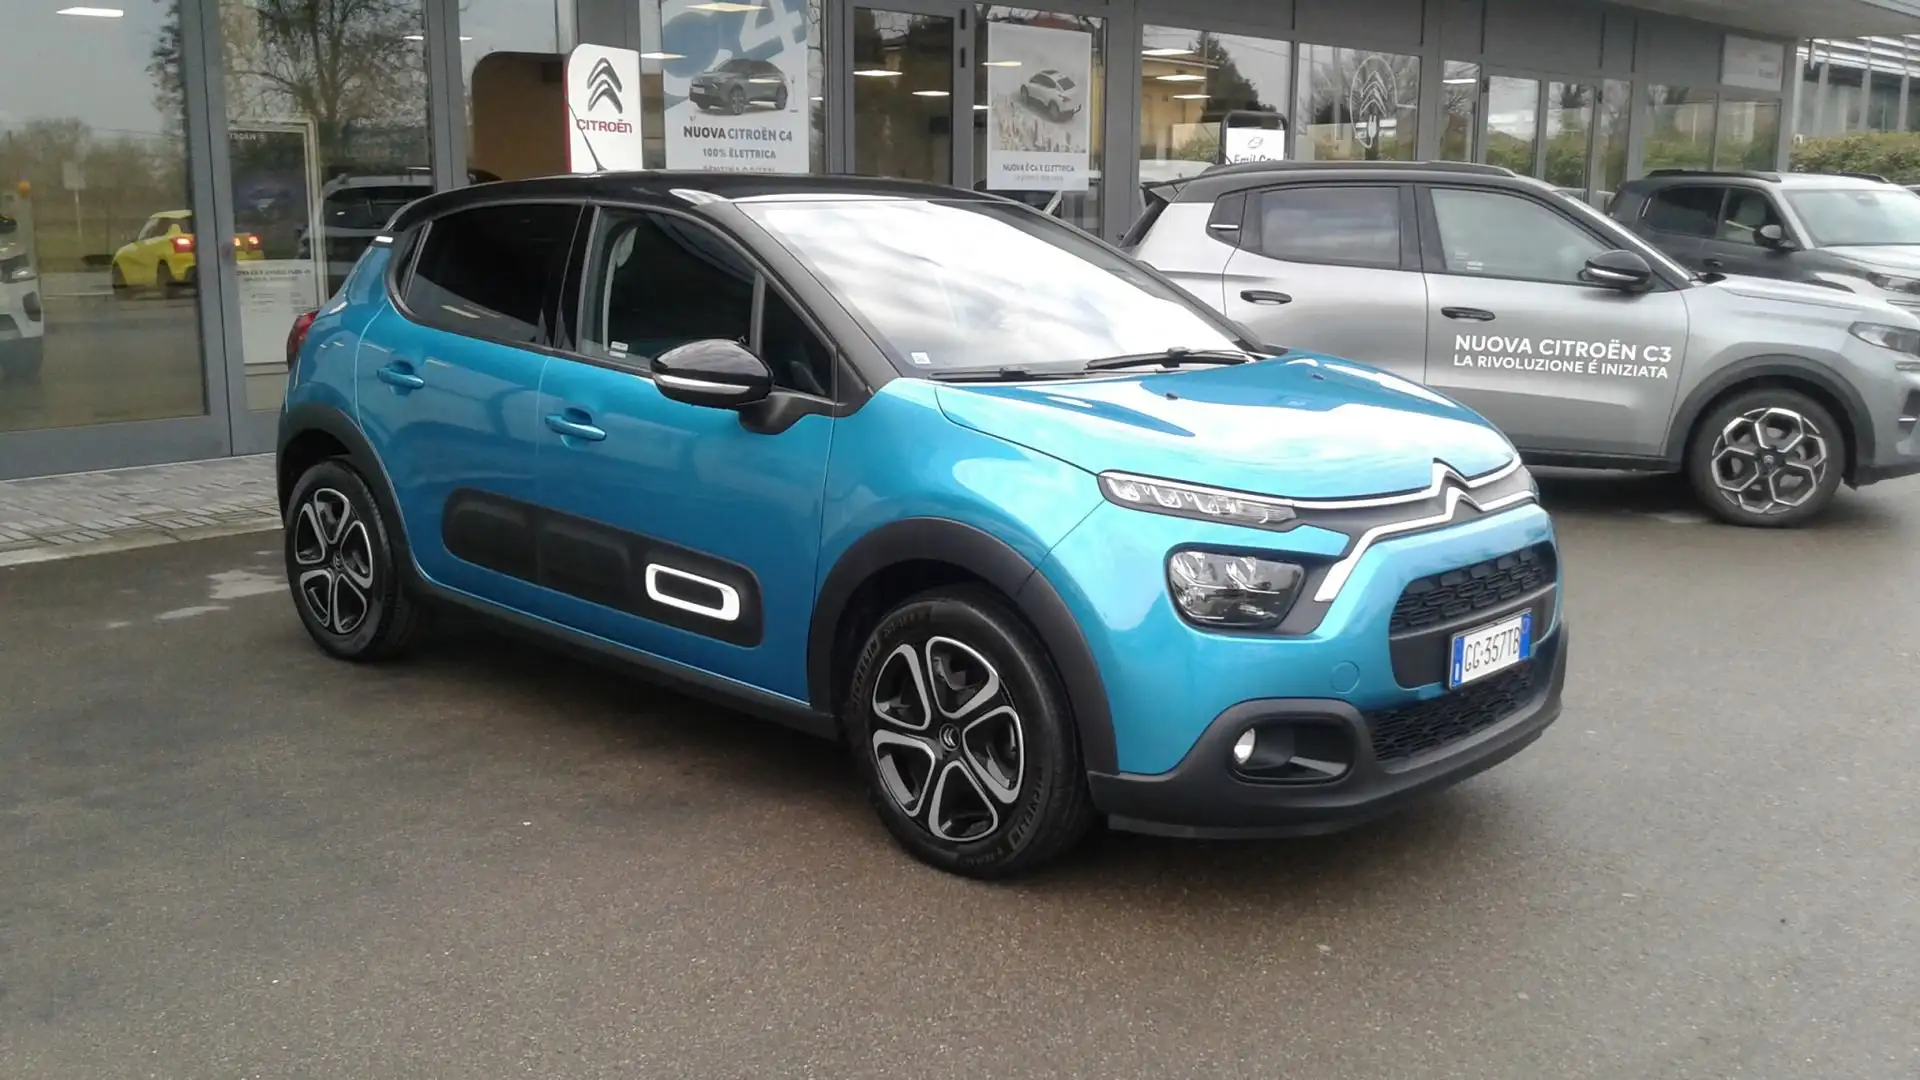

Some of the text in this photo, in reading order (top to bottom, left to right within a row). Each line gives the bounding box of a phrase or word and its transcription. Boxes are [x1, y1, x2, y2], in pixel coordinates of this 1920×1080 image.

[683, 125, 793, 142] NUOVA CITROËN C4
[702, 147, 728, 158] 100%
[1455, 334, 1672, 363] NUOVA CITROËN C3
[1454, 354, 1473, 366] LA
[1477, 355, 1585, 373] RIVOLUZIONE
[1601, 362, 1668, 379] INIZIATA
